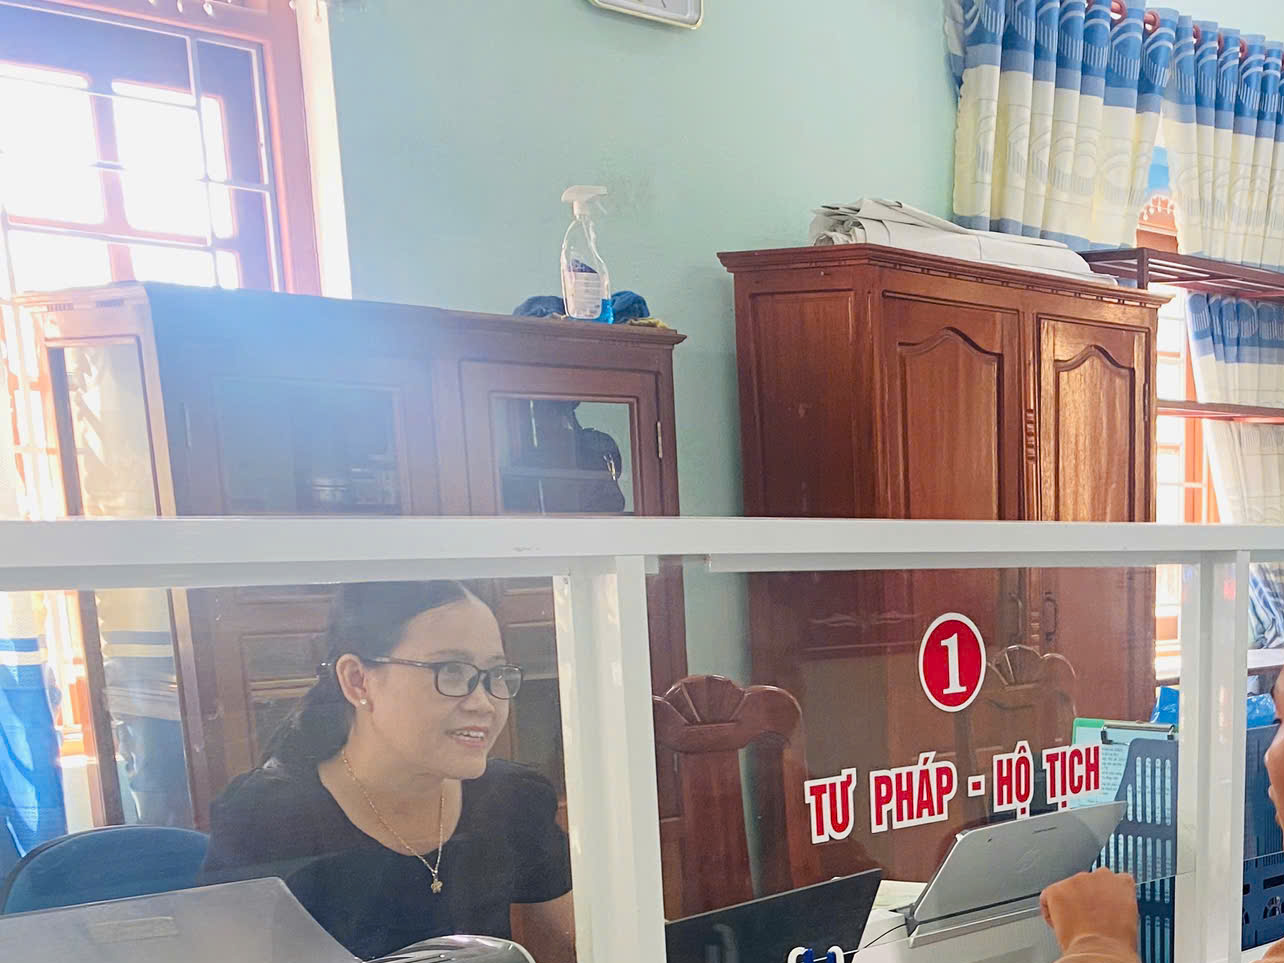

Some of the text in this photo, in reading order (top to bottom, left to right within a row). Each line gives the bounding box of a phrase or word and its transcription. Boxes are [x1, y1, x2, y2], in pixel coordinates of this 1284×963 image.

[940, 632, 967, 694] 1
[808, 769, 855, 839] TƯ
[874, 754, 955, 828] PHÁP
[995, 743, 1033, 815] HỘ
[1044, 743, 1101, 809] TỊCH
